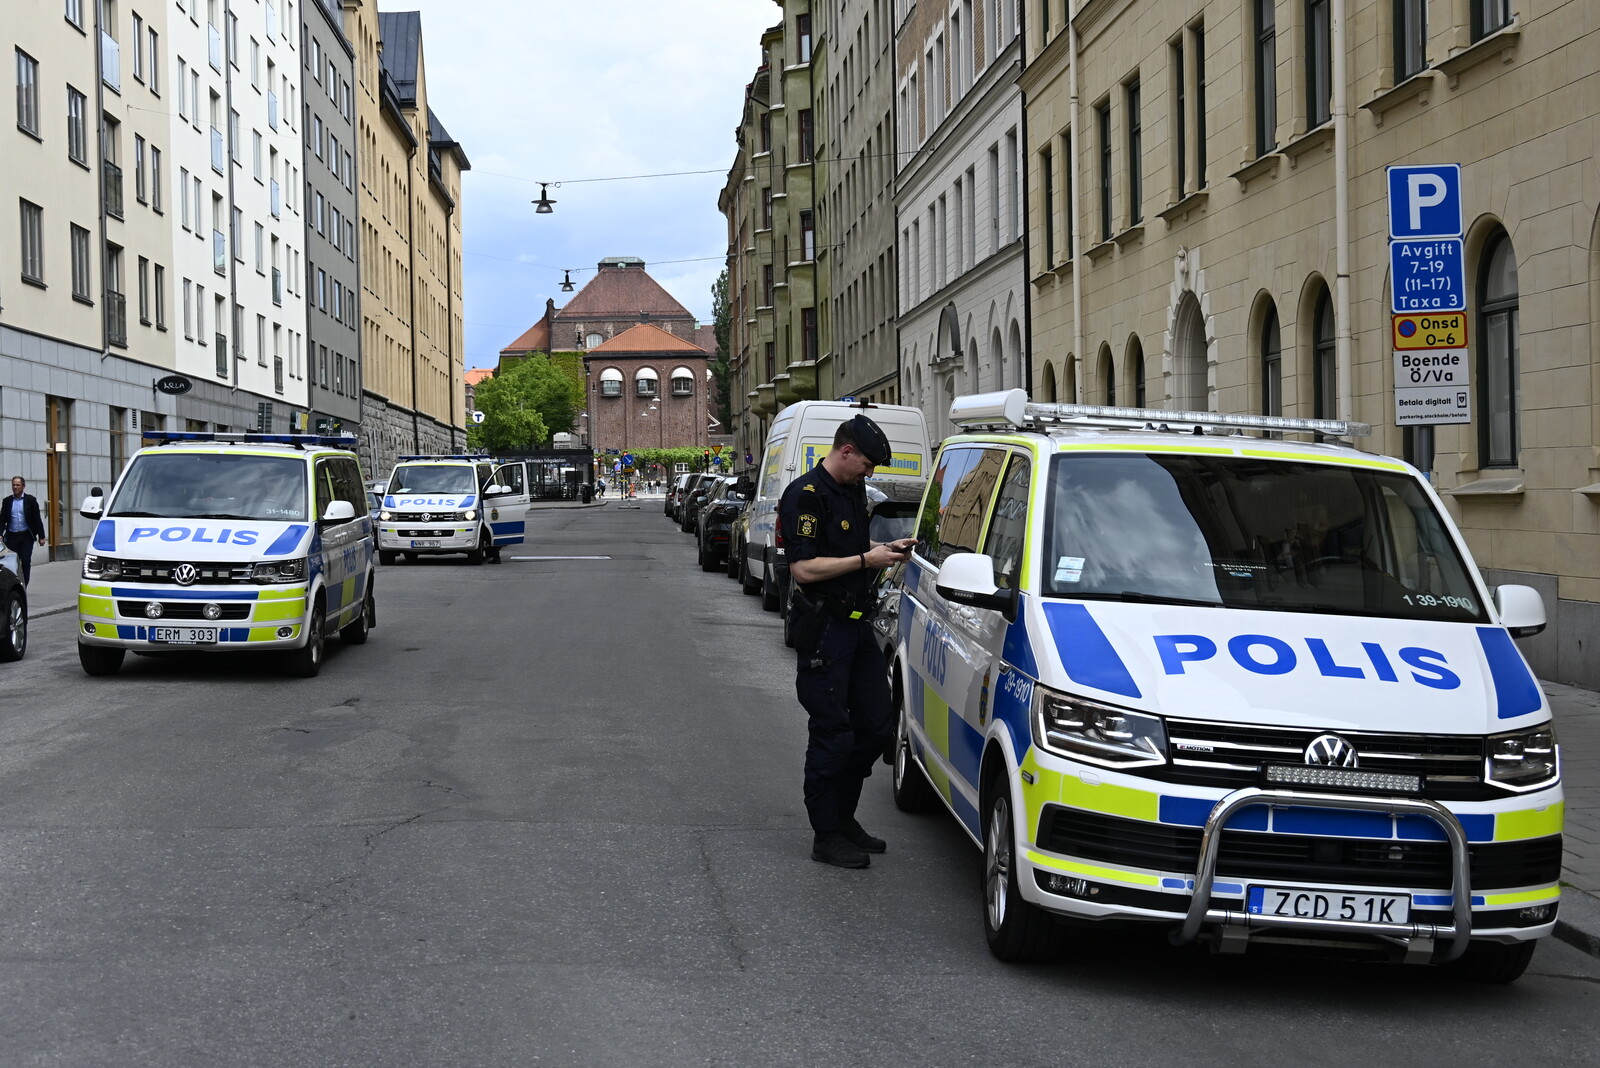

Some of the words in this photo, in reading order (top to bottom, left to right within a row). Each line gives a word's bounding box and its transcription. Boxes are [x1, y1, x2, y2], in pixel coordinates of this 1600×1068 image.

[1408, 173, 1447, 230] P
[1401, 243, 1453, 259] Avgift
[1410, 261, 1444, 274] 7-19
[1405, 276, 1451, 292] (11-17)
[1400, 296, 1441, 308] Taxa
[1448, 294, 1458, 307] 3
[1420, 317, 1459, 330] Onsd
[1401, 353, 1460, 367] Boende
[1410, 367, 1454, 383] Ö/Va
[1425, 398, 1451, 406] digitalt
[399, 498, 456, 506] POLIS
[800, 515, 816, 523] POLIS
[127, 526, 259, 545] POLIS
[1402, 594, 1414, 606] 1
[1415, 594, 1473, 609] 39-1910
[156, 628, 181, 640] ERM
[189, 629, 213, 641] 303
[921, 618, 947, 687] POLIS
[1152, 633, 1461, 690] POLIS
[1004, 671, 1031, 703] 39-1910
[1252, 905, 1258, 913] S
[1274, 892, 1329, 918] ZCD
[1339, 896, 1396, 922] 51K
